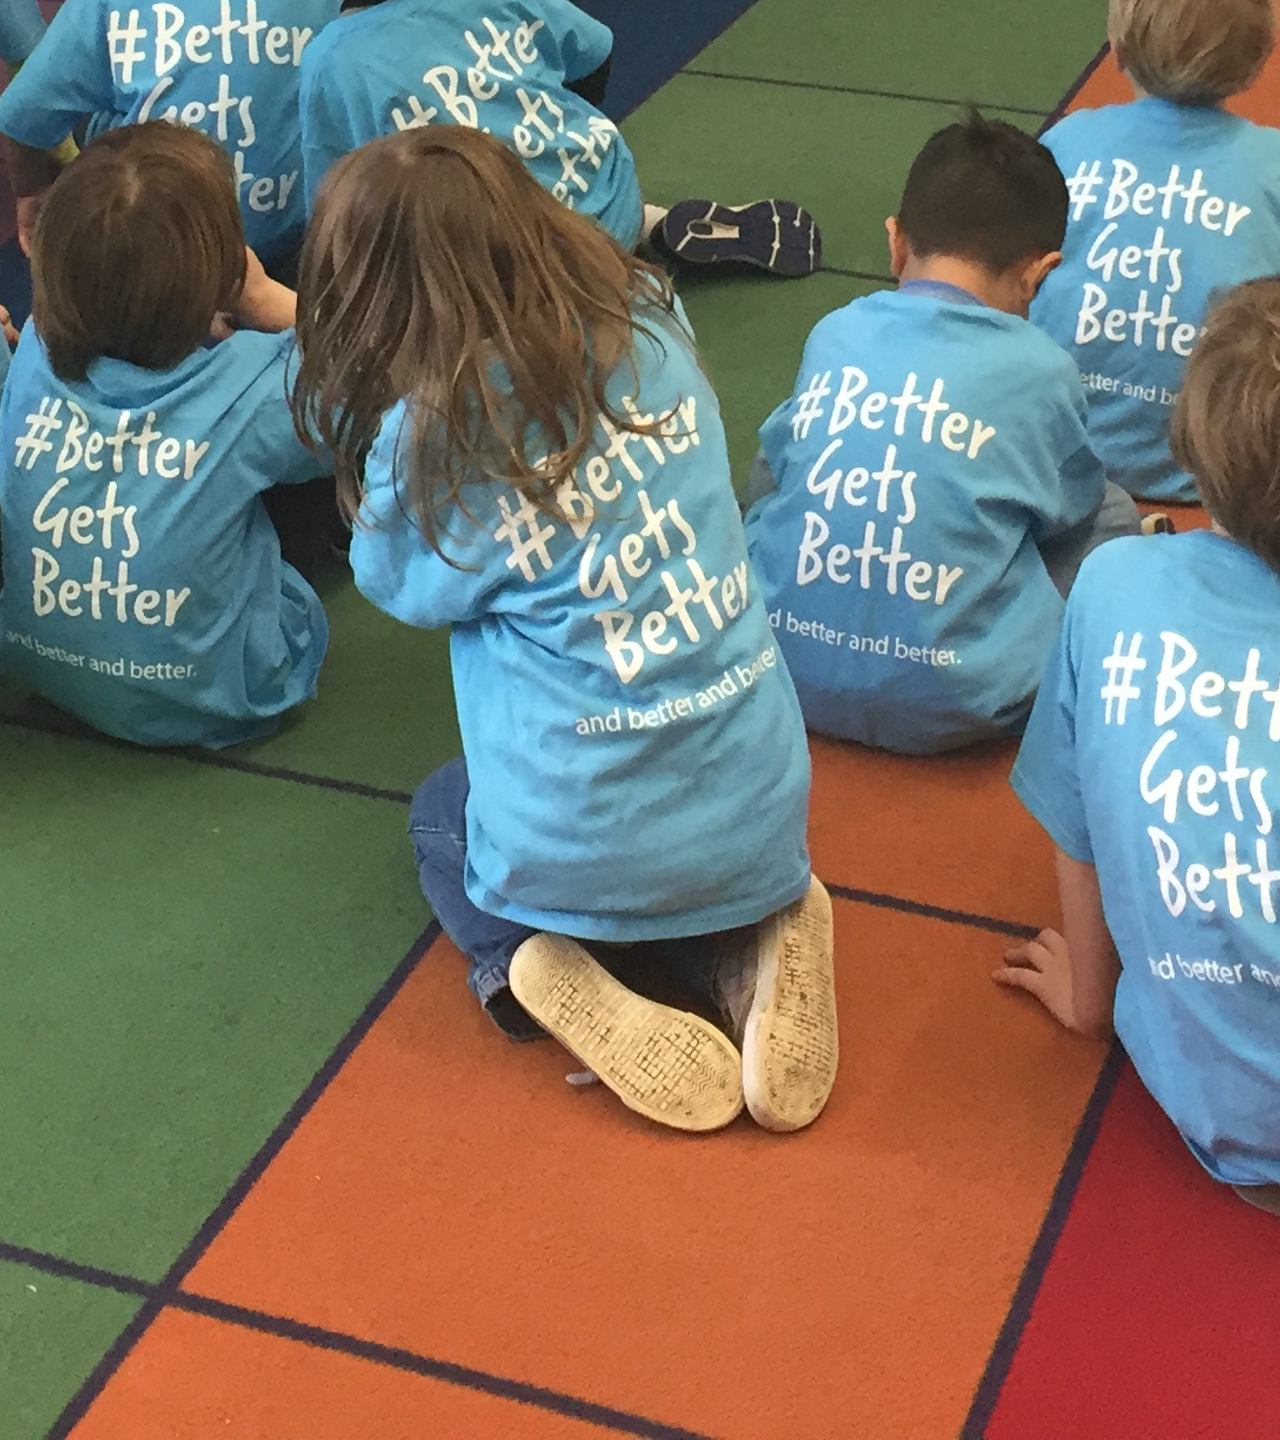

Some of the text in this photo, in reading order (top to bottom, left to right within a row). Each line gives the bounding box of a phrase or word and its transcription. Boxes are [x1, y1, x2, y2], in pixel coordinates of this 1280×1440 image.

[1065, 157, 1252, 237] #Better
[1086, 222, 1182, 293] Gets
[1074, 282, 1209, 357] Bette
[791, 366, 996, 459] #Better
[1080, 372, 1120, 394] etter
[1123, 380, 1157, 403] and
[14, 397, 210, 481] #Better
[32, 477, 140, 559] Gets
[494, 396, 700, 583] #Better
[806, 438, 917, 524] Gets
[31, 547, 192, 627] Better
[578, 490, 697, 603] Gets
[796, 511, 964, 605] Better
[593, 558, 748, 685] Better
[786, 611, 845, 647] better
[849, 634, 889, 656] and
[895, 637, 963, 665] better.
[88, 658, 125, 676] and
[129, 660, 197, 680] better.
[575, 707, 622, 736] and
[628, 696, 695, 729] better
[698, 672, 739, 707] and
[1139, 729, 1274, 835] Gets
[1176, 954, 1244, 984] better
